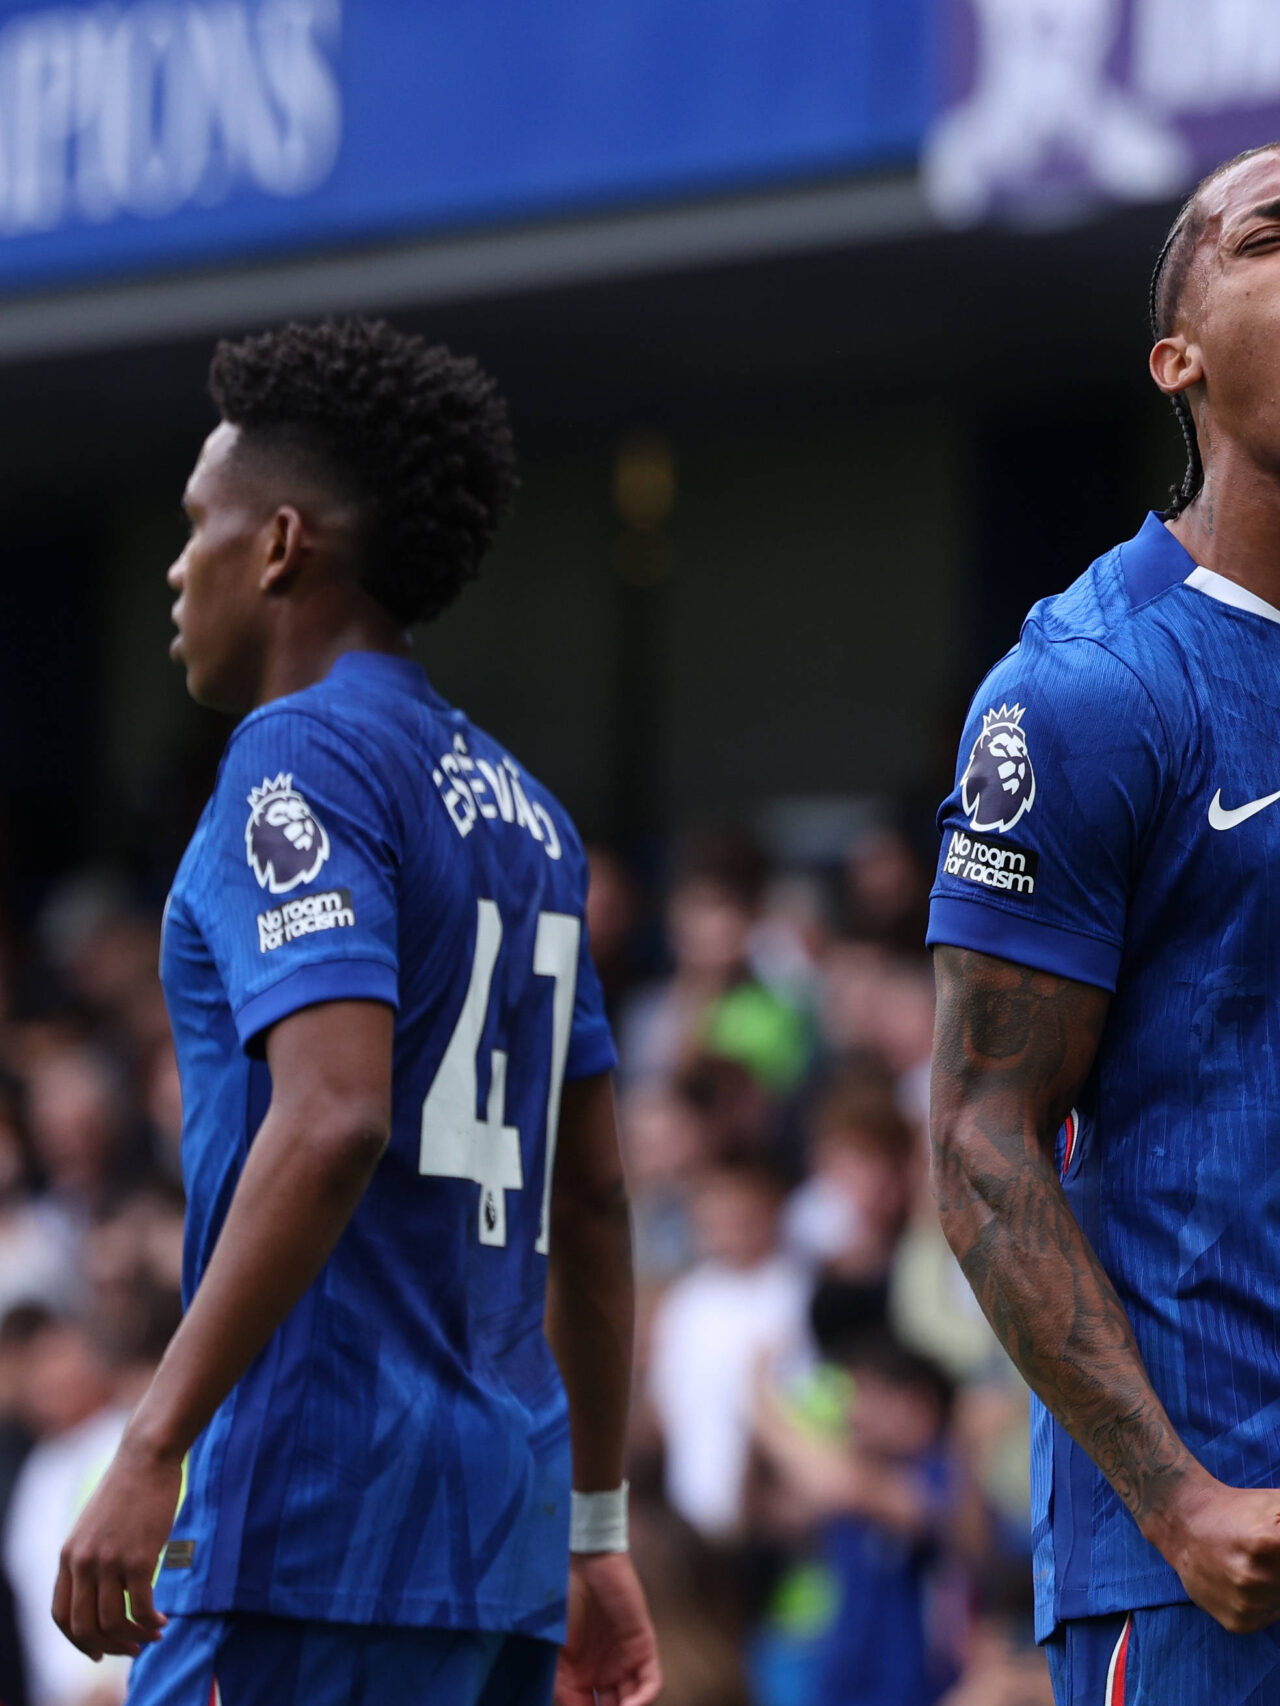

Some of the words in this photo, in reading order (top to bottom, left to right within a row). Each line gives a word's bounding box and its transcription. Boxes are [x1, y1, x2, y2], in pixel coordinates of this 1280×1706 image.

[943, 850, 966, 875] for
[962, 860, 1034, 894] racism
[949, 831, 971, 856] No
[971, 841, 1026, 872] room
[257, 909, 283, 935] No
[282, 891, 342, 924] room
[260, 928, 283, 954] for
[284, 907, 355, 942] racism
[418, 897, 581, 1256] 41
